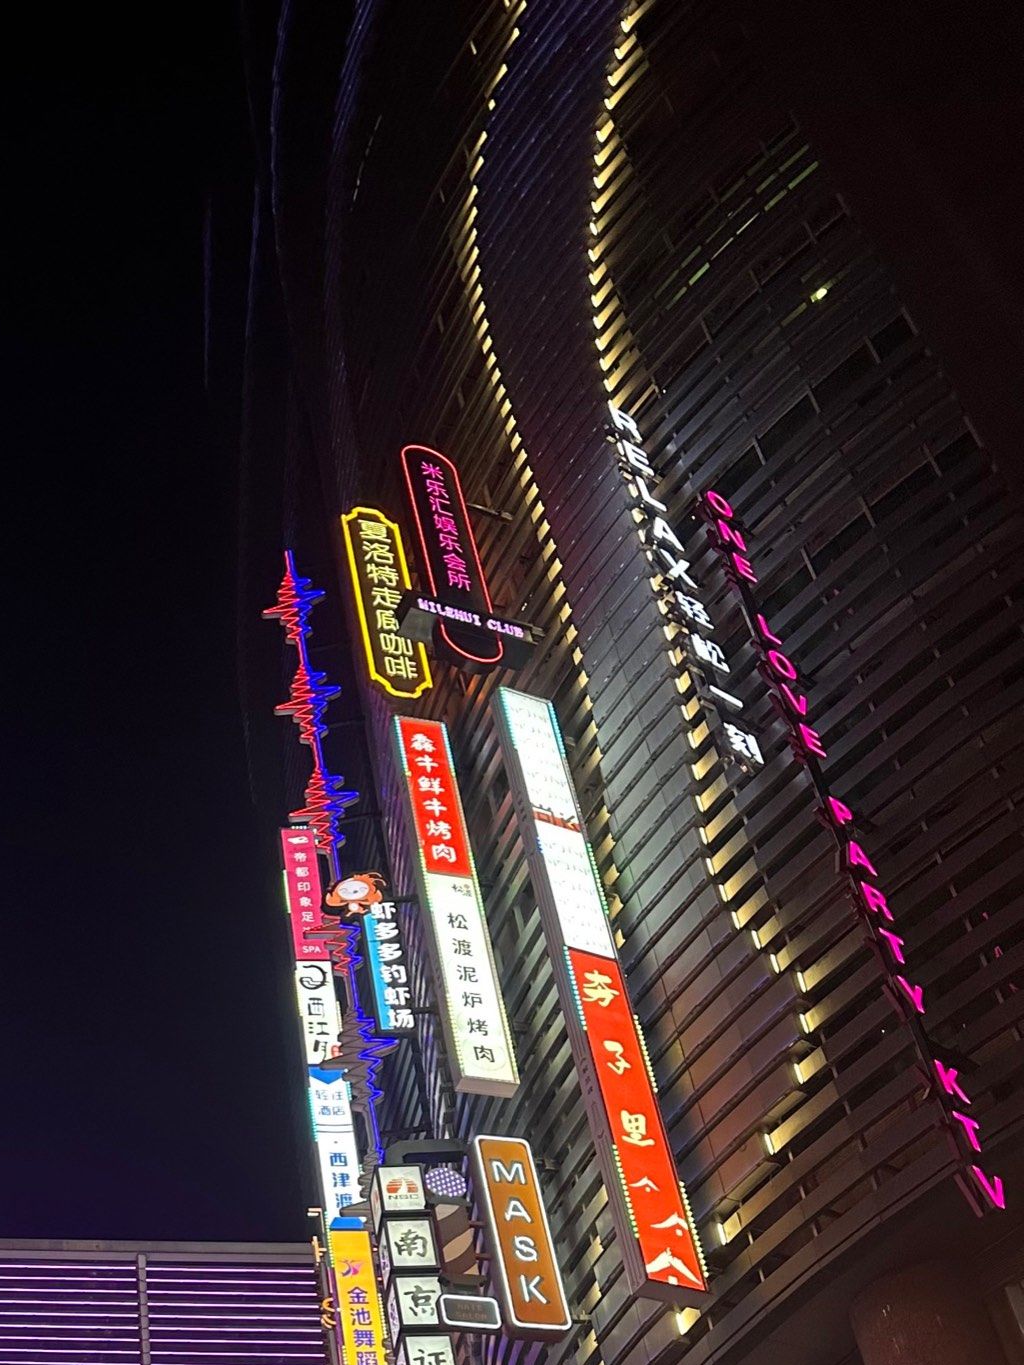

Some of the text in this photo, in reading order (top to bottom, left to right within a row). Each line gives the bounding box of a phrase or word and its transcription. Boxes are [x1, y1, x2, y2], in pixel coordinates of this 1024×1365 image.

[421, 461, 472, 592] 米乐汇娱乐会所
[608, 400, 698, 590] RELAX
[358, 519, 419, 679] 夏洛特走廊咖啡
[487, 618, 525, 639] CLUB
[294, 852, 315, 930] 帝都印象足
[706, 490, 1005, 1211] ONE LOVE PARTY KTV
[302, 945, 322, 954] SPA
[370, 901, 416, 1029] 虾多多钓虾场
[447, 911, 495, 1062] 松渡泥炉烤肉
[318, 1104, 346, 1117] 酒店
[493, 1160, 547, 1305] MASK
